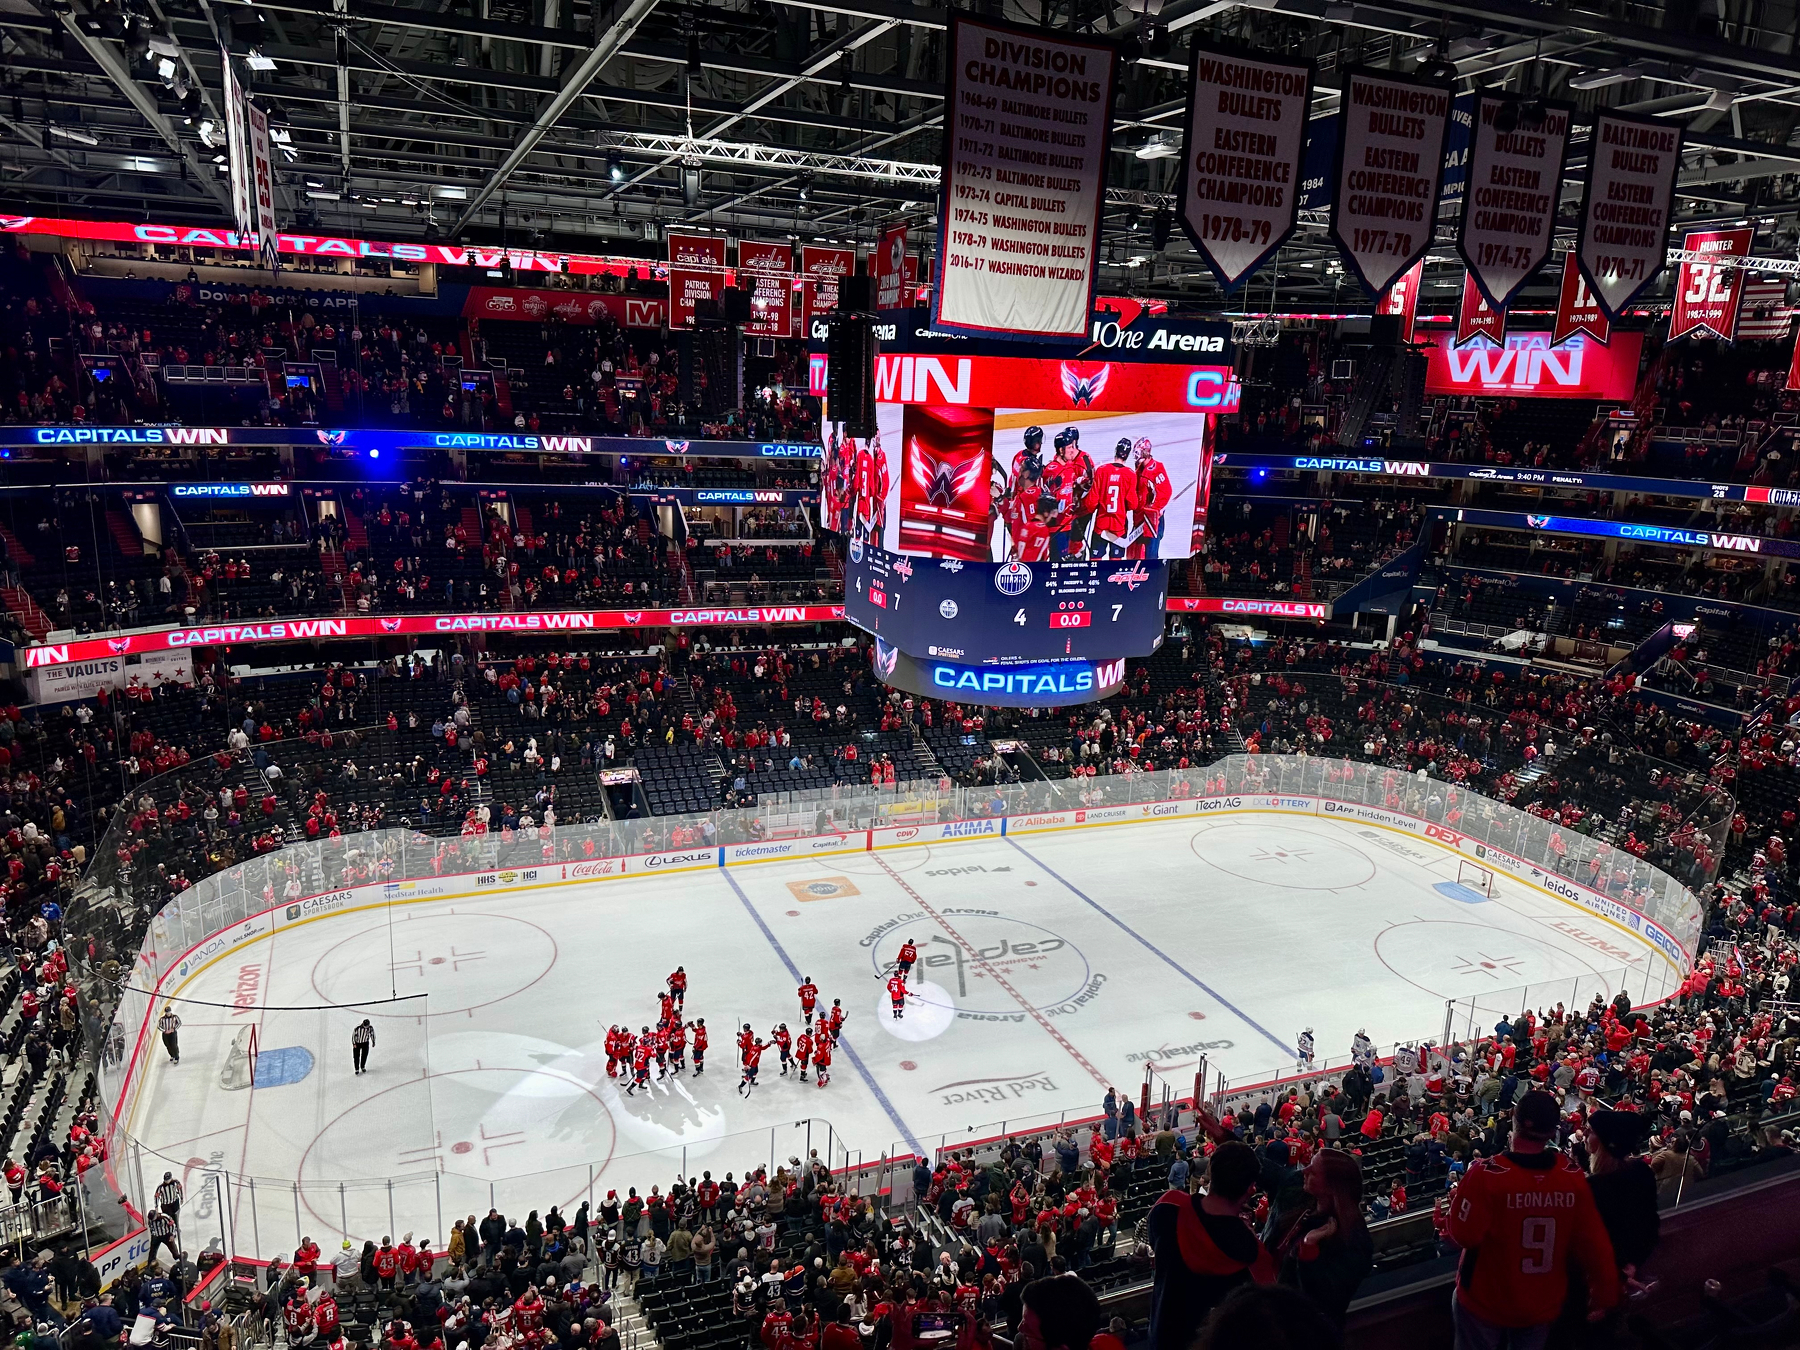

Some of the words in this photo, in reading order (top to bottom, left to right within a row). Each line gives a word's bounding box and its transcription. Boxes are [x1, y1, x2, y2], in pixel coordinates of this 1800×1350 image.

[985, 37, 1086, 76] DIVISION
[965, 60, 1101, 103] CHAMPIONS
[1199, 58, 1305, 97] WASHINGTON
[960, 91, 997, 110] 1968-69
[1001, 100, 1051, 121] BALTIMORE
[1053, 109, 1088, 125] BULLETS
[1218, 91, 1282, 121] BULLETS
[1352, 82, 1447, 117] WASHINGTON
[960, 114, 995, 133] 1970-71
[1000, 122, 1049, 143] BALTIMORE
[1051, 132, 1086, 148] BULLETS
[1369, 112, 1426, 140] BULLETS
[1602, 123, 1675, 153] BALTIMORE
[959, 137, 994, 157] 1971-72
[998, 146, 1047, 166] BALTIMORE
[1049, 154, 1084, 170] BULLETS
[1214, 127, 1277, 157] EASTERN
[1495, 134, 1546, 158] BULLETS
[1196, 152, 1291, 184] CONFERENCE
[1364, 147, 1420, 173] EASTERN
[1612, 150, 1659, 175] BULLETS
[957, 161, 991, 180] 1972-73
[996, 169, 1045, 188] BALTIMORE
[1047, 176, 1081, 192] BULLETS
[1302, 177, 1324, 190] 1984
[1348, 170, 1431, 199] CONFERENCE
[1490, 165, 1541, 190] EASTERN
[955, 185, 990, 202] 1973-74
[994, 192, 1028, 209] CAPITAL
[1031, 198, 1066, 213] BULLETS
[1197, 178, 1283, 208] CHAMPIONS
[1475, 187, 1549, 215] CONFERENCE
[1607, 181, 1654, 205] EASTERN
[1349, 195, 1424, 222] CHAMPIONS
[1593, 202, 1662, 227] CONFERENCE
[954, 208, 988, 225] 1974-75
[993, 215, 1050, 234] WASHINGTON
[1053, 222, 1087, 237] BULLETS
[1202, 214, 1272, 245] 1978-79
[1475, 211, 1542, 237] CHAMPIONS
[953, 231, 987, 248] 1978-79
[991, 237, 1049, 256] WASHINGTON
[1051, 244, 1085, 259] BULLETS
[1353, 228, 1412, 257] 1977-78
[1593, 225, 1656, 248] CHAMPIONS
[1701, 240, 1733, 252] HUNTER
[438, 247, 562, 272] WIN
[950, 254, 984, 271] 2016-17
[988, 259, 1046, 278] WASHINGTON
[1048, 266, 1085, 281] WIZARDS
[1478, 242, 1532, 270] 1974-75
[1595, 255, 1645, 280] 1970-71
[684, 289, 712, 300] DIVISION
[685, 280, 710, 290] PATRICK
[1685, 262, 1732, 303] 32
[1686, 309, 1723, 319] 1987-1999
[1148, 329, 1224, 353] Arena
[1447, 350, 1584, 386] WIN
[36, 428, 163, 444] CAPITALS
[165, 428, 228, 444] WIN
[436, 435, 539, 449] CAPITALS
[541, 436, 591, 452] WIN
[1295, 457, 1381, 472] CAPITALS
[1384, 461, 1430, 476] WIN
[1517, 473, 1532, 481] 9:40
[1532, 474, 1545, 482] PM
[174, 485, 250, 496] CAPITALS
[251, 484, 288, 495] WIN
[697, 492, 753, 502] CAPITALS
[754, 491, 783, 502] WIN
[1107, 485, 1119, 513] 3
[1713, 490, 1725, 498] 28
[1620, 525, 1709, 545] CAPITALS
[1711, 534, 1761, 552] WIN
[855, 576, 862, 592] 4
[894, 593, 901, 610] 7
[670, 609, 760, 623] CAPITALS
[762, 607, 806, 621] WIN
[1013, 608, 1027, 626] 4
[1060, 614, 1081, 626] 0.0
[1111, 604, 1123, 622] 7
[1222, 600, 1307, 616] CAPITALS
[168, 624, 286, 646] CAPITALS
[289, 619, 346, 638] WIN
[435, 616, 541, 631] CAPITALS
[543, 613, 594, 628] WIN
[938, 646, 965, 656] CAESARS
[47, 670, 63, 679] THE
[65, 660, 119, 678] VAULTS
[934, 667, 1093, 694] CAPITALS
[1087, 812, 1101, 820] LAND
[1102, 809, 1126, 819] CRUISER
[1152, 804, 1178, 817] Giant
[1195, 799, 1223, 811] iTech
[1224, 797, 1242, 809] AG
[941, 819, 995, 838] AKIMA
[1025, 815, 1065, 828] Alibaba
[1357, 809, 1391, 825] Hidden
[1391, 816, 1417, 831] Level
[896, 830, 914, 838] CDW
[1424, 824, 1464, 848] DEX
[663, 852, 711, 863] LEXUS
[735, 843, 792, 857] ticketmaster
[1487, 848, 1521, 869] CAESARS
[477, 875, 495, 885] HHS
[523, 870, 537, 880] HCI
[925, 865, 988, 877] leidos
[303, 890, 353, 910] CAESARS
[384, 888, 415, 899] MedStar
[416, 886, 444, 896] Health
[1543, 876, 1580, 902] leidos
[303, 900, 345, 917] SPORTSBOOK
[1584, 900, 1626, 922] AIRLINES
[1594, 896, 1627, 916] UNITED
[859, 918, 899, 947] Capital
[897, 910, 925, 922] One
[941, 907, 999, 916] Arena
[187, 938, 226, 966] VANDA
[1645, 923, 1680, 961] GEICO
[229, 963, 262, 1017] verizon
[1073, 973, 1108, 1008] Capital
[956, 1012, 1026, 1023] Arena
[1045, 1002, 1078, 1018] One
[943, 1085, 1005, 1106] River
[1007, 1076, 1060, 1100] Red
[1458, 1198, 1472, 1222] 9
[1507, 1192, 1575, 1209] LEONARD
[1522, 1217, 1556, 1274] 9
[379, 1258, 394, 1271] 43
[767, 1285, 781, 1298] 43
